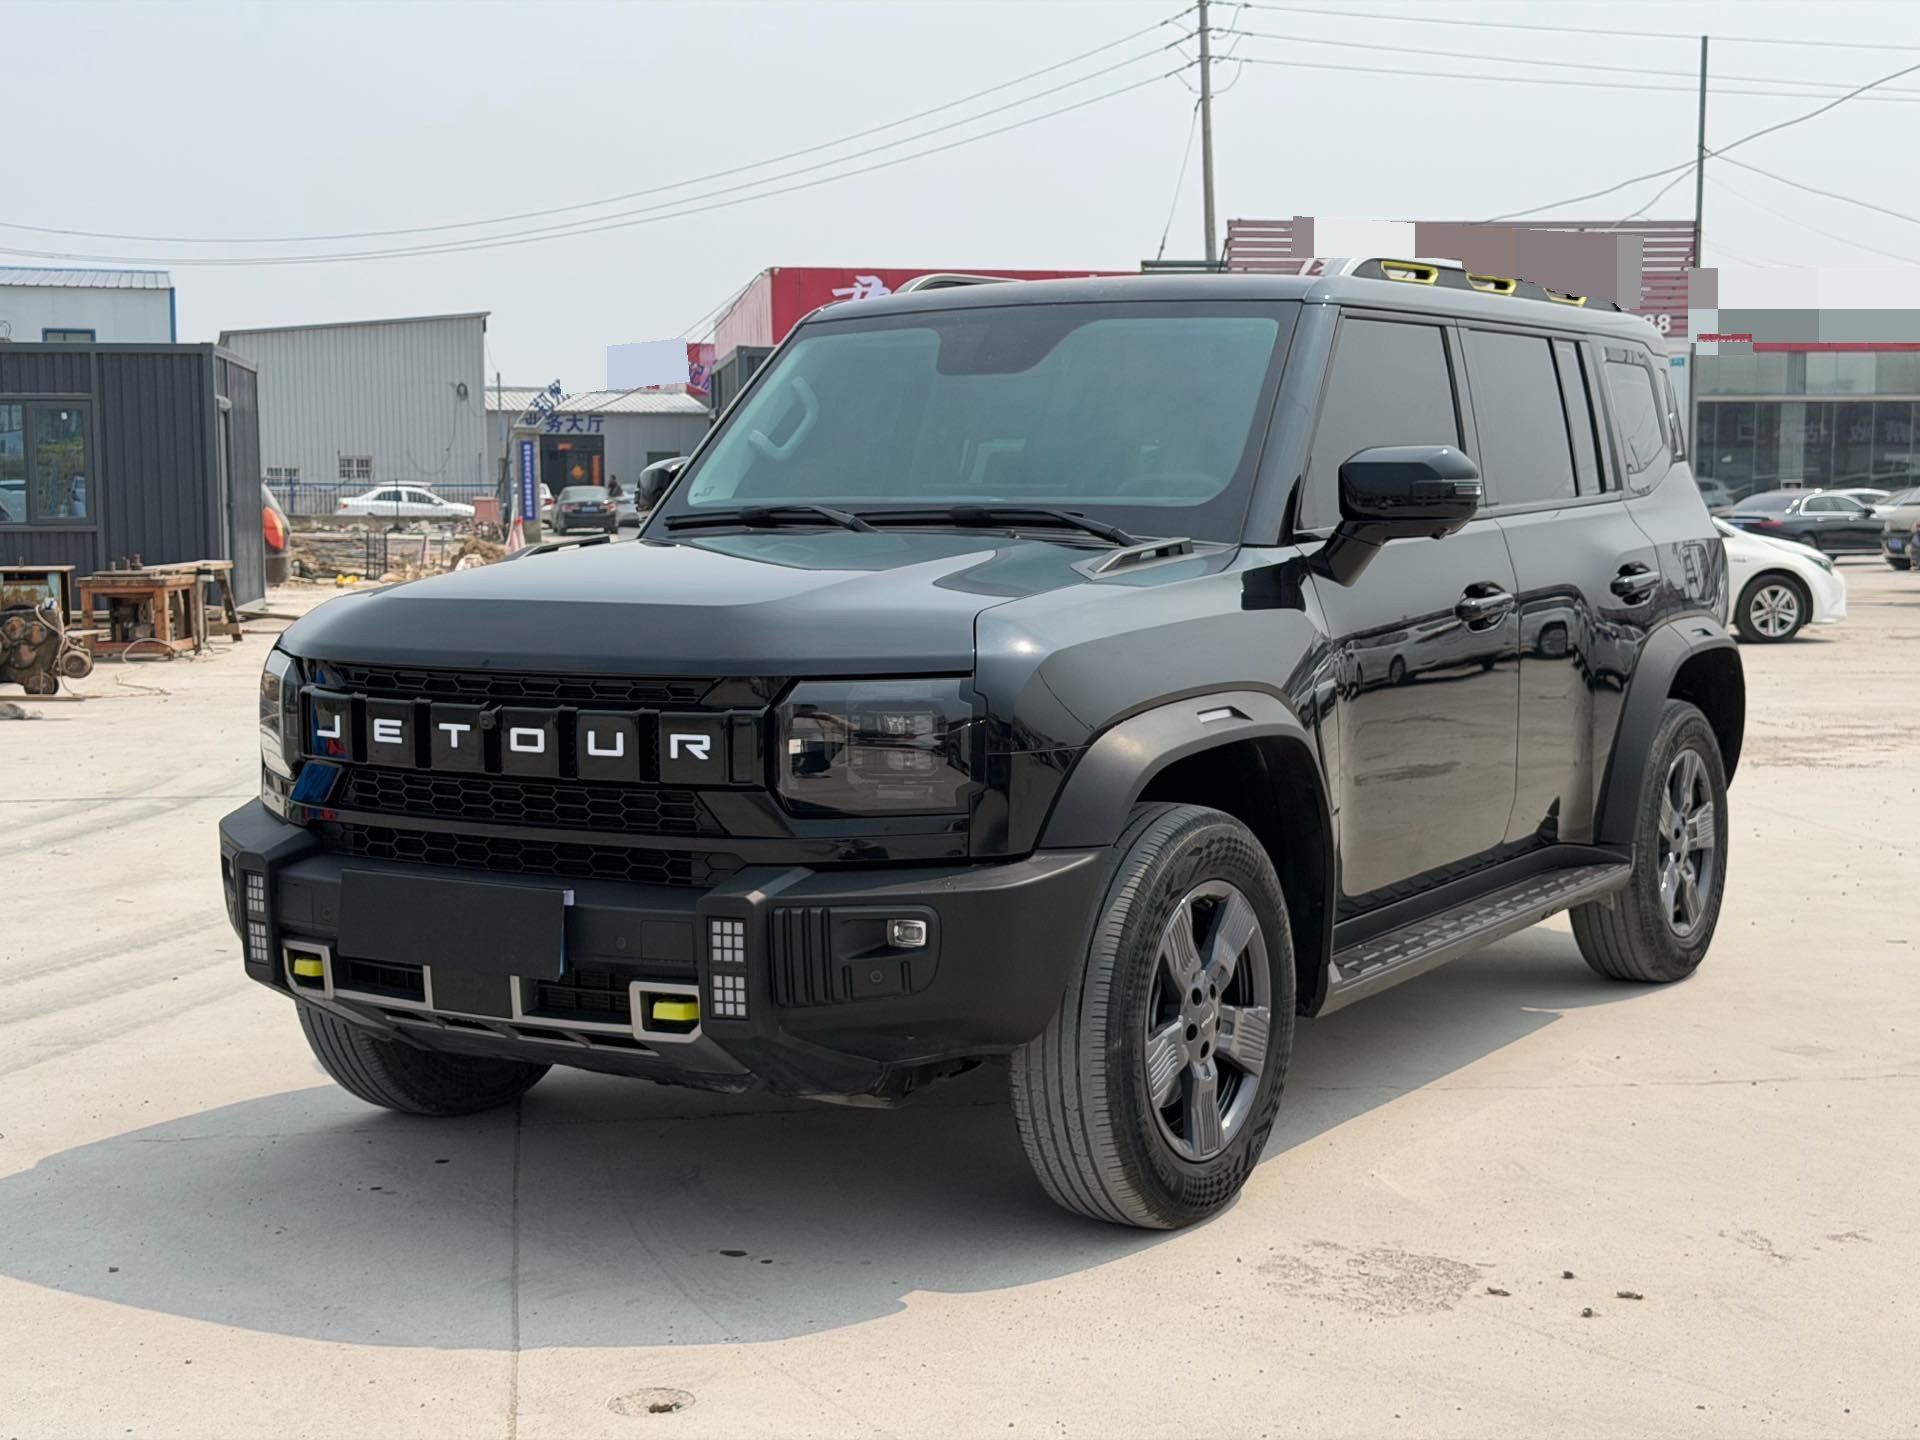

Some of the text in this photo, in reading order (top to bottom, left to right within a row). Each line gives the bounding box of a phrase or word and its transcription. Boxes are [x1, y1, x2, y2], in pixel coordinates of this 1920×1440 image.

[525, 413, 605, 433] 业务大厅
[316, 715, 711, 760] JETOUR
